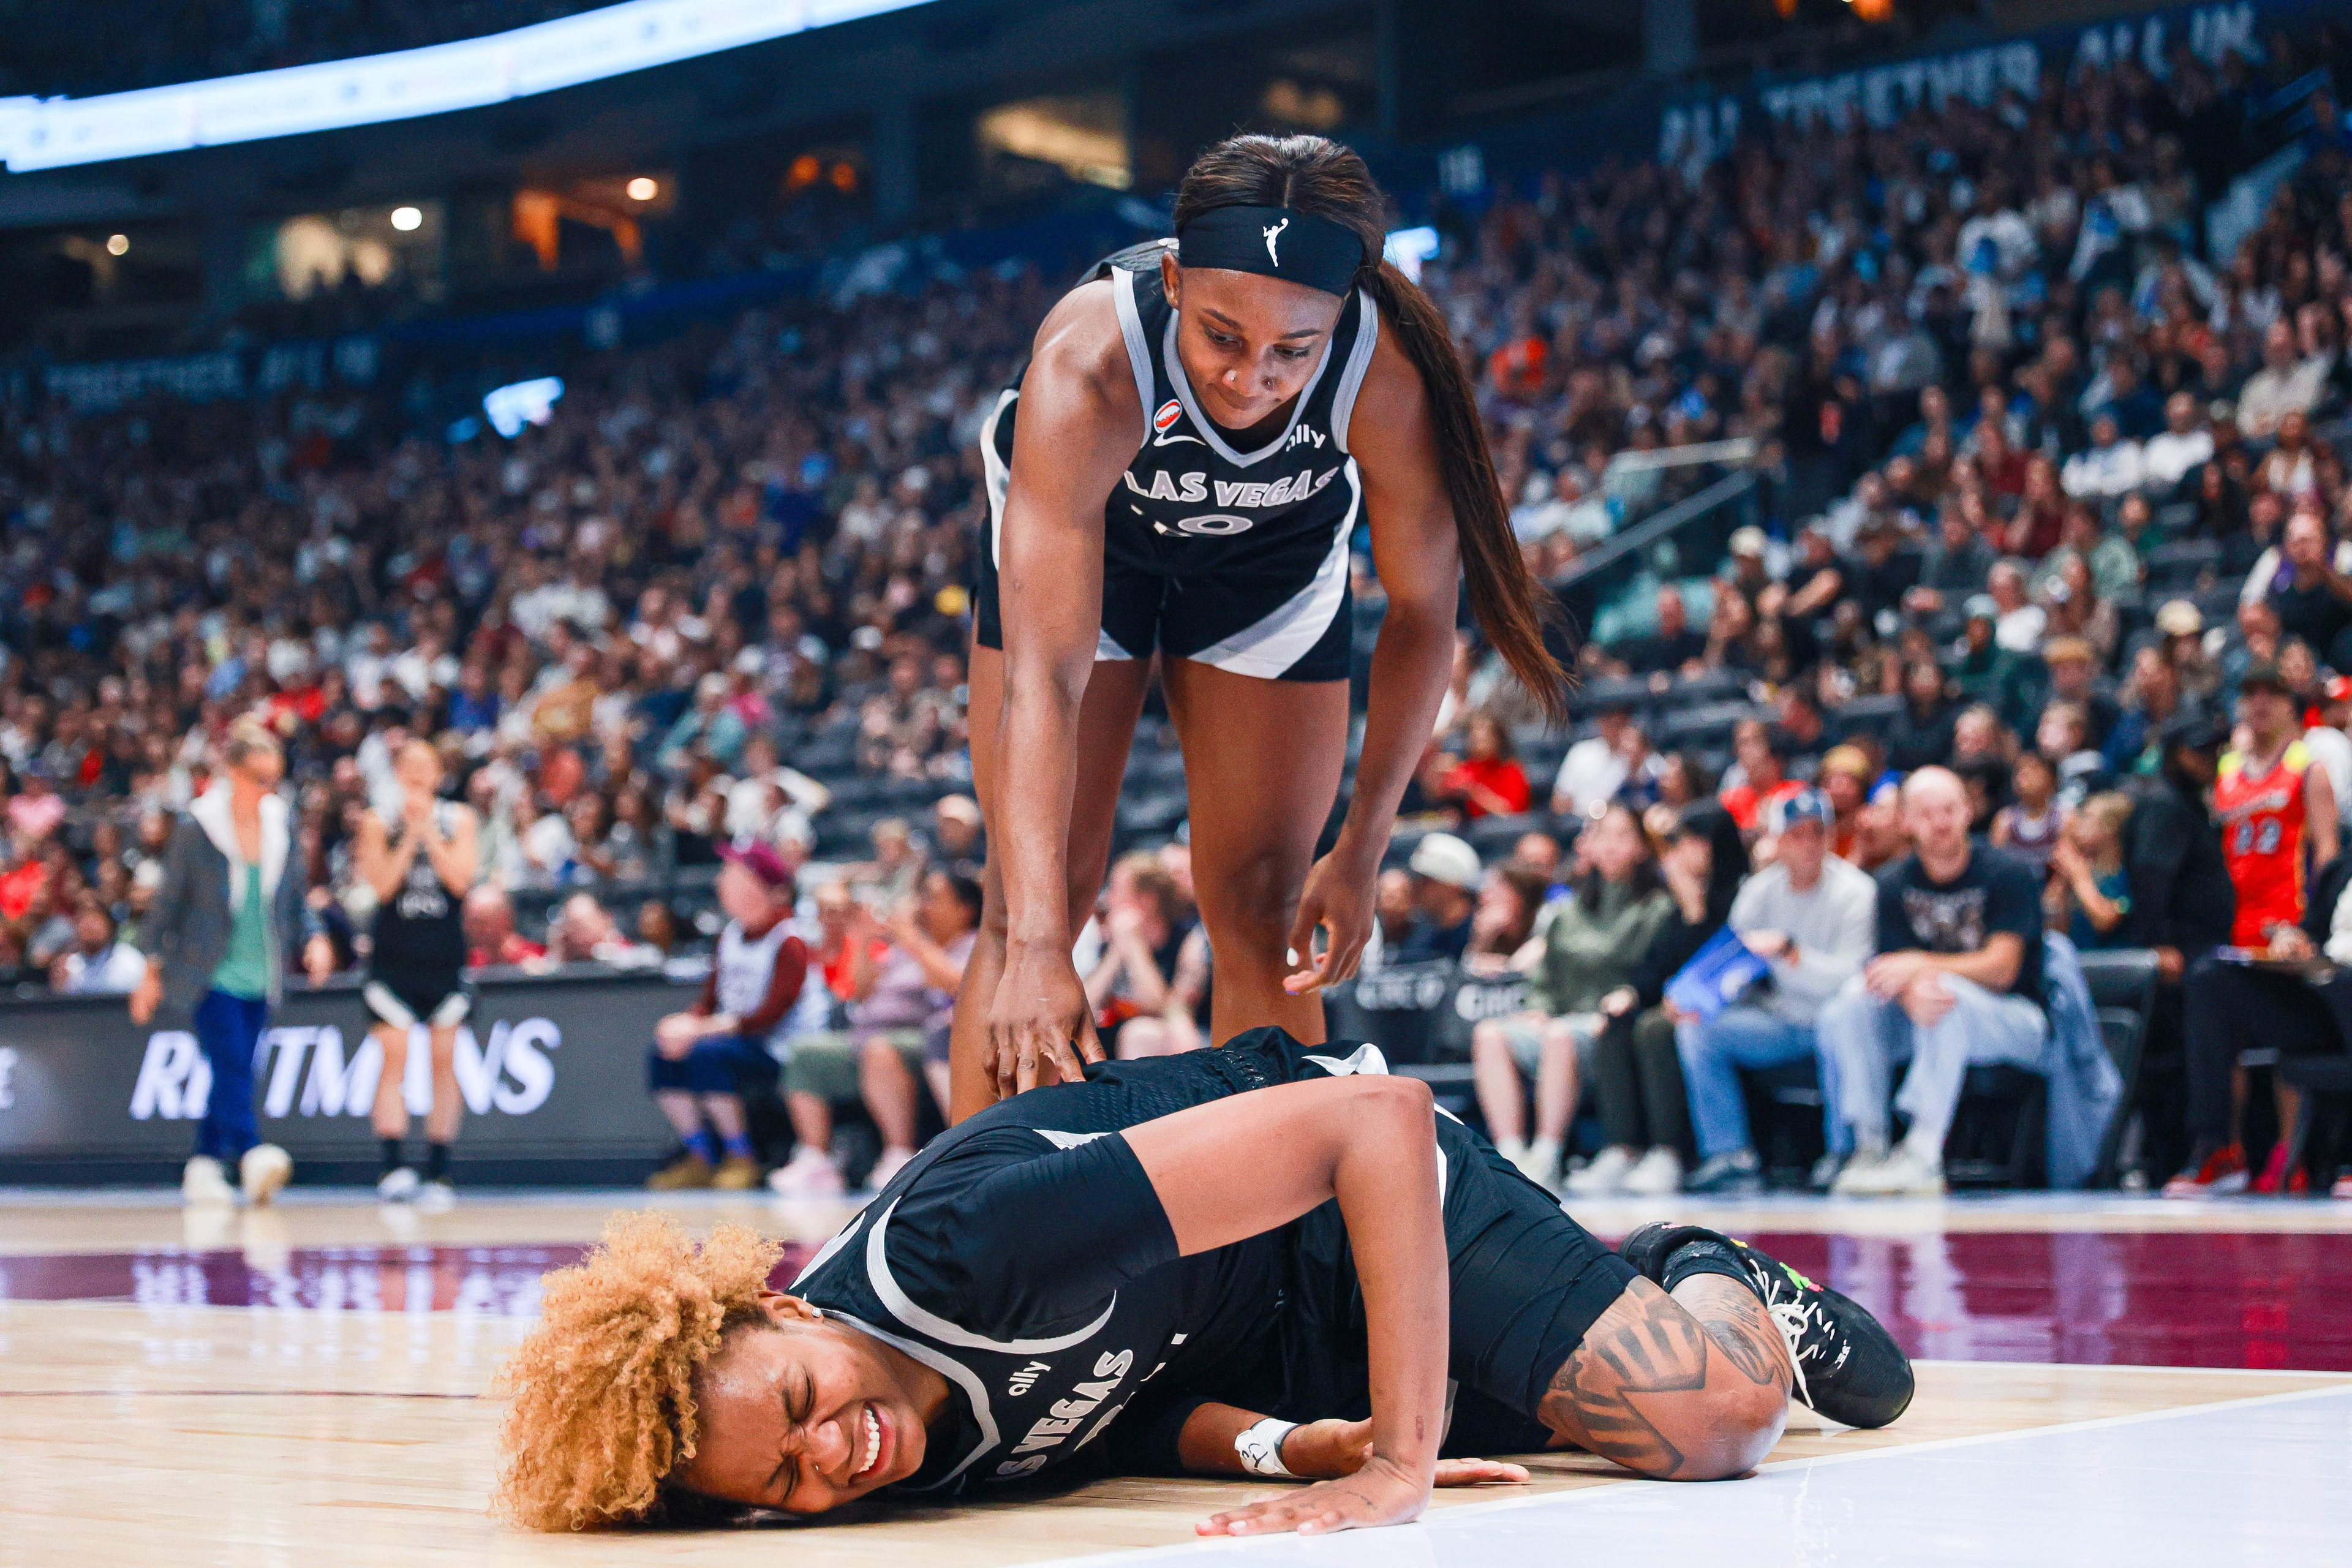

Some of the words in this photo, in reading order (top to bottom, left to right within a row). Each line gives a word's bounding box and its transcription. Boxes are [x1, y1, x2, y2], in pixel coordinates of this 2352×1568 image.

[1123, 470, 1208, 503] LAS
[1213, 466, 1340, 508] VEGAS
[1008, 1360, 1051, 1396] ally
[1011, 1349, 1134, 1454] VEGAS
